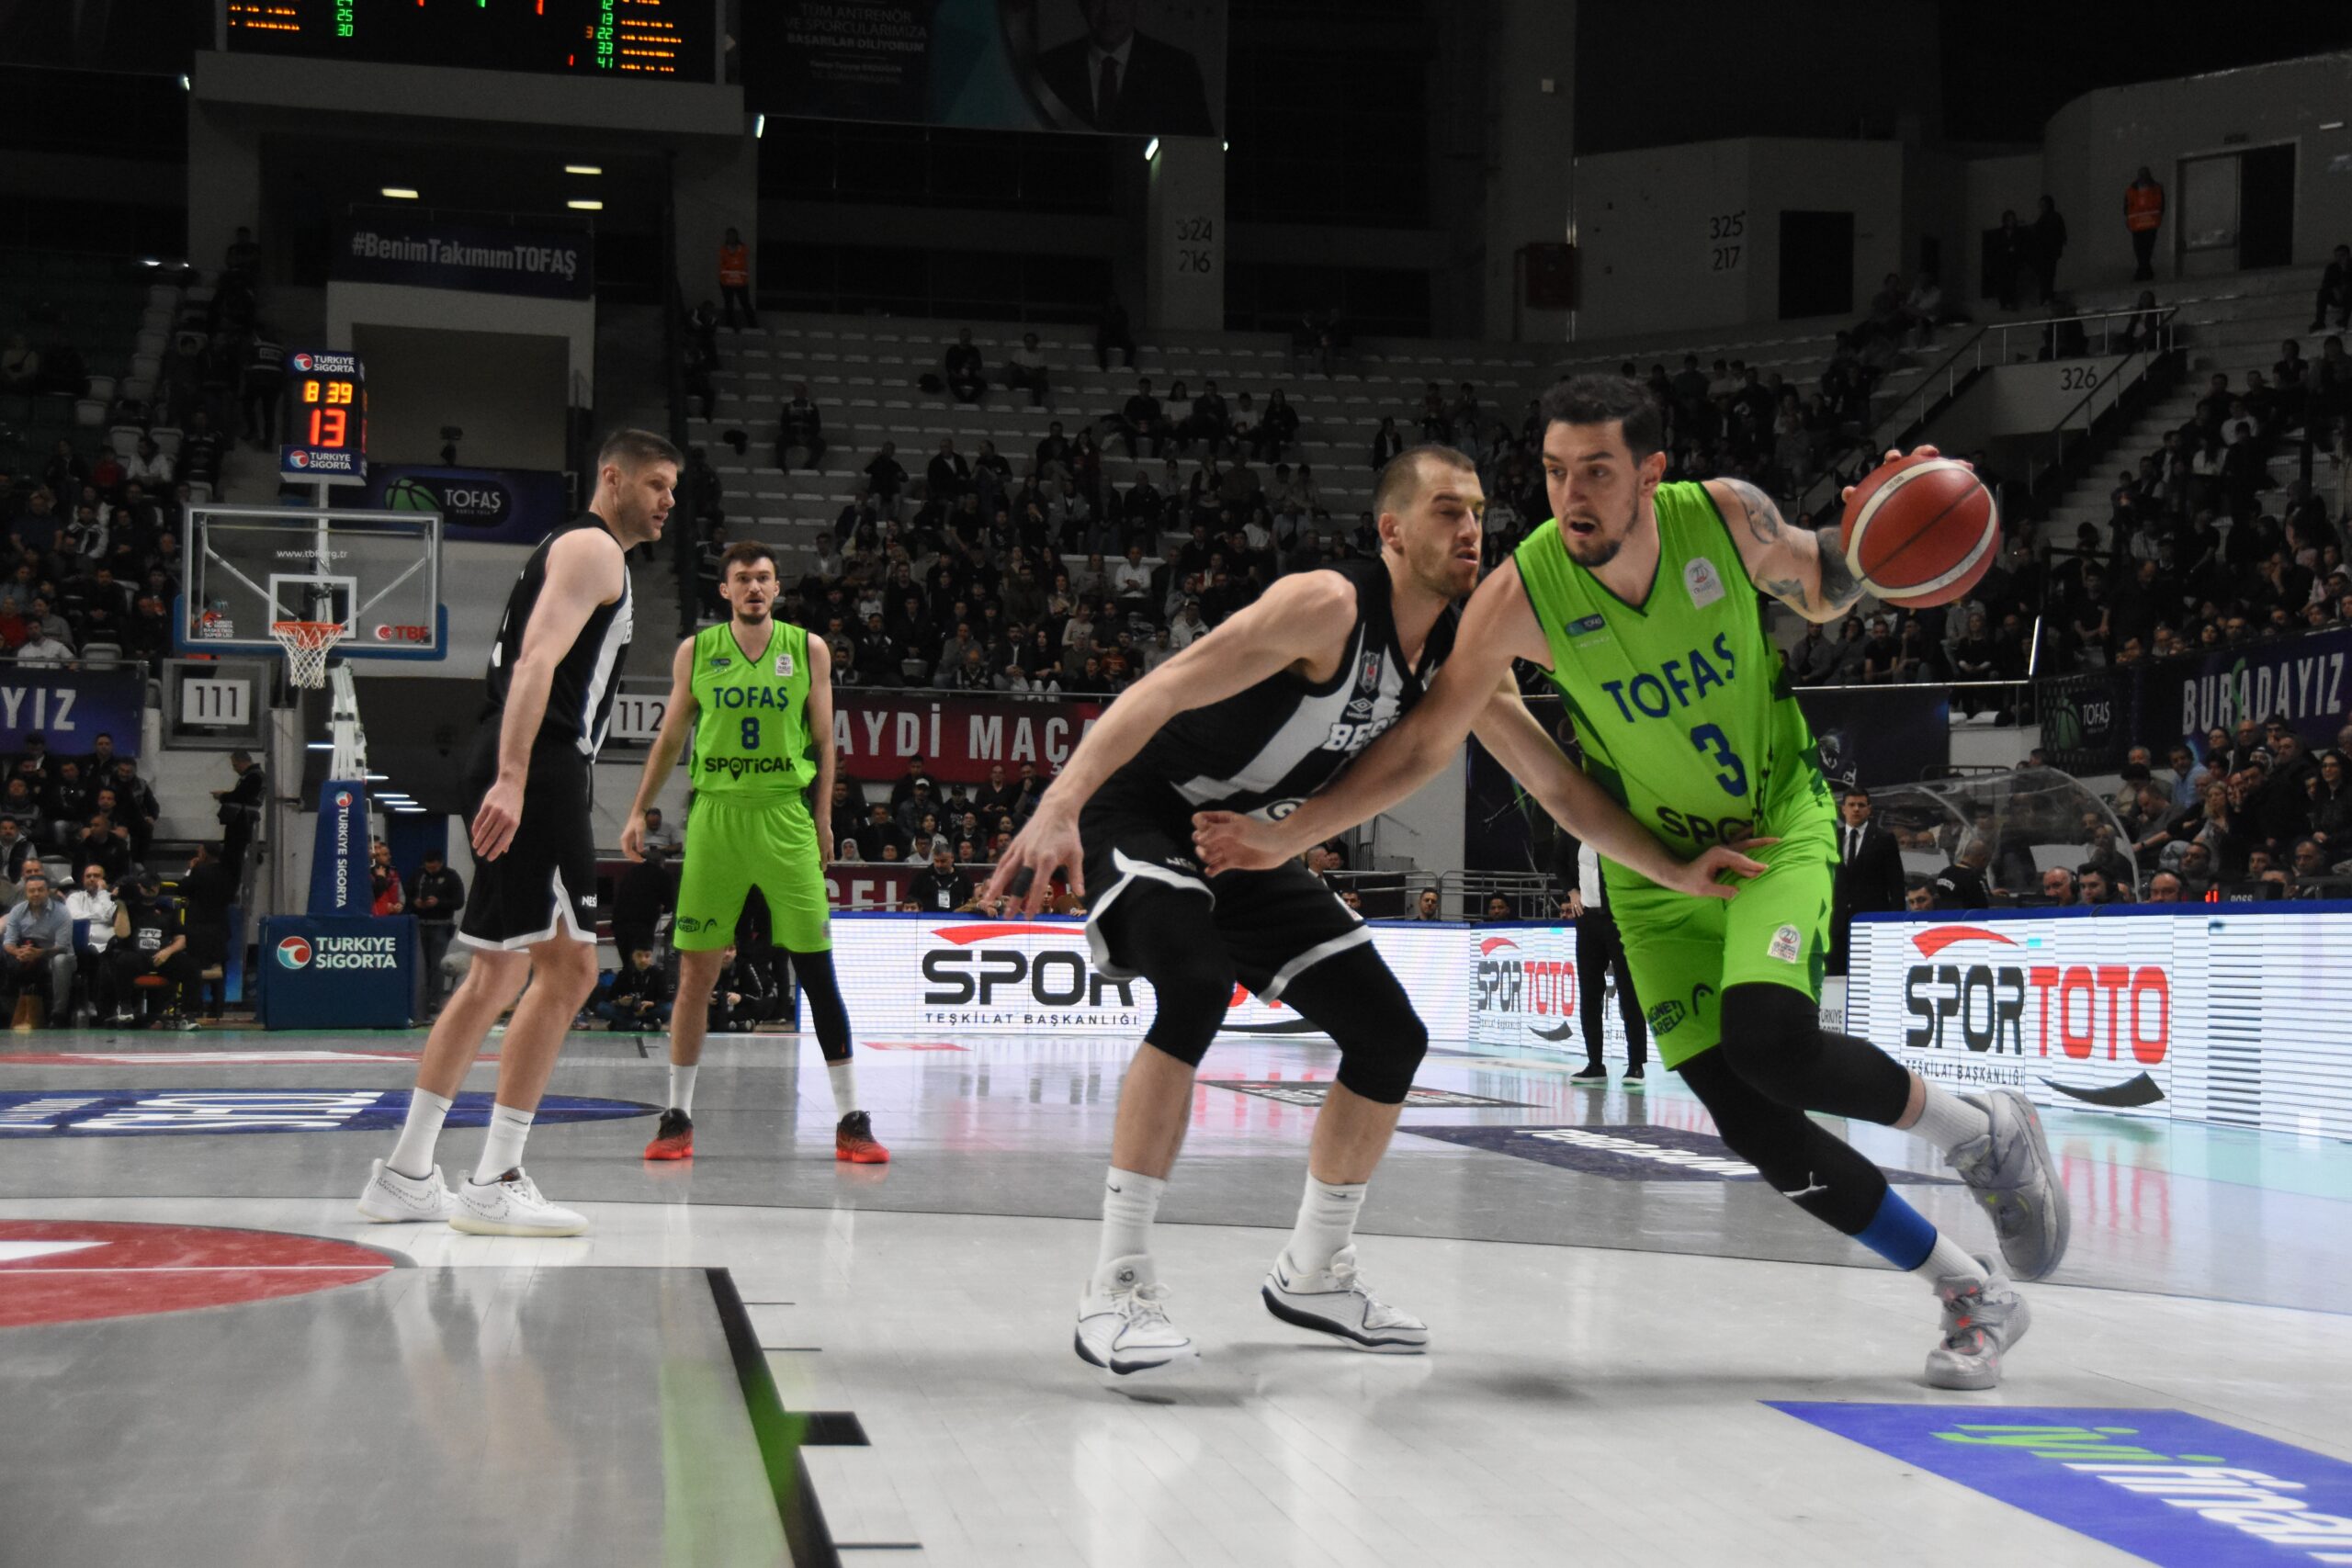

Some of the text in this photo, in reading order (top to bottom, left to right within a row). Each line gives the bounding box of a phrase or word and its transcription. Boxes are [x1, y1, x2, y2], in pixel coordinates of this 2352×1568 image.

[337, 9, 353, 21] 25
[603, 13, 614, 25] 13
[337, 24, 353, 36] 30
[597, 27, 614, 39] 22
[598, 41, 613, 54] 33
[597, 56, 614, 68] 41
[1176, 220, 1212, 241] 324
[1710, 210, 1746, 239] 325
[351, 231, 578, 281] #BenimTakımımTOFAŞ
[1179, 250, 1211, 273] 216
[1713, 245, 1741, 270] 217
[2061, 366, 2097, 390] 326
[304, 380, 353, 404] 8 39
[310, 408, 346, 447] 13
[444, 489, 503, 513] TOFAŞ
[396, 626, 428, 641] TBF
[195, 685, 238, 717] 111
[713, 685, 790, 713] TOFAŞ
[618, 701, 666, 732] 112
[2082, 700, 2110, 728] TOFAŞ
[741, 716, 761, 750] 8
[1690, 722, 1749, 798] 3
[1476, 960, 1522, 1013] SPOR
[1523, 960, 1576, 1018] TOTO
[925, 1011, 1137, 1027] TEŞKİLAT BAŞKANLIĞI
[1905, 964, 2169, 1066] SPOR TOTO
